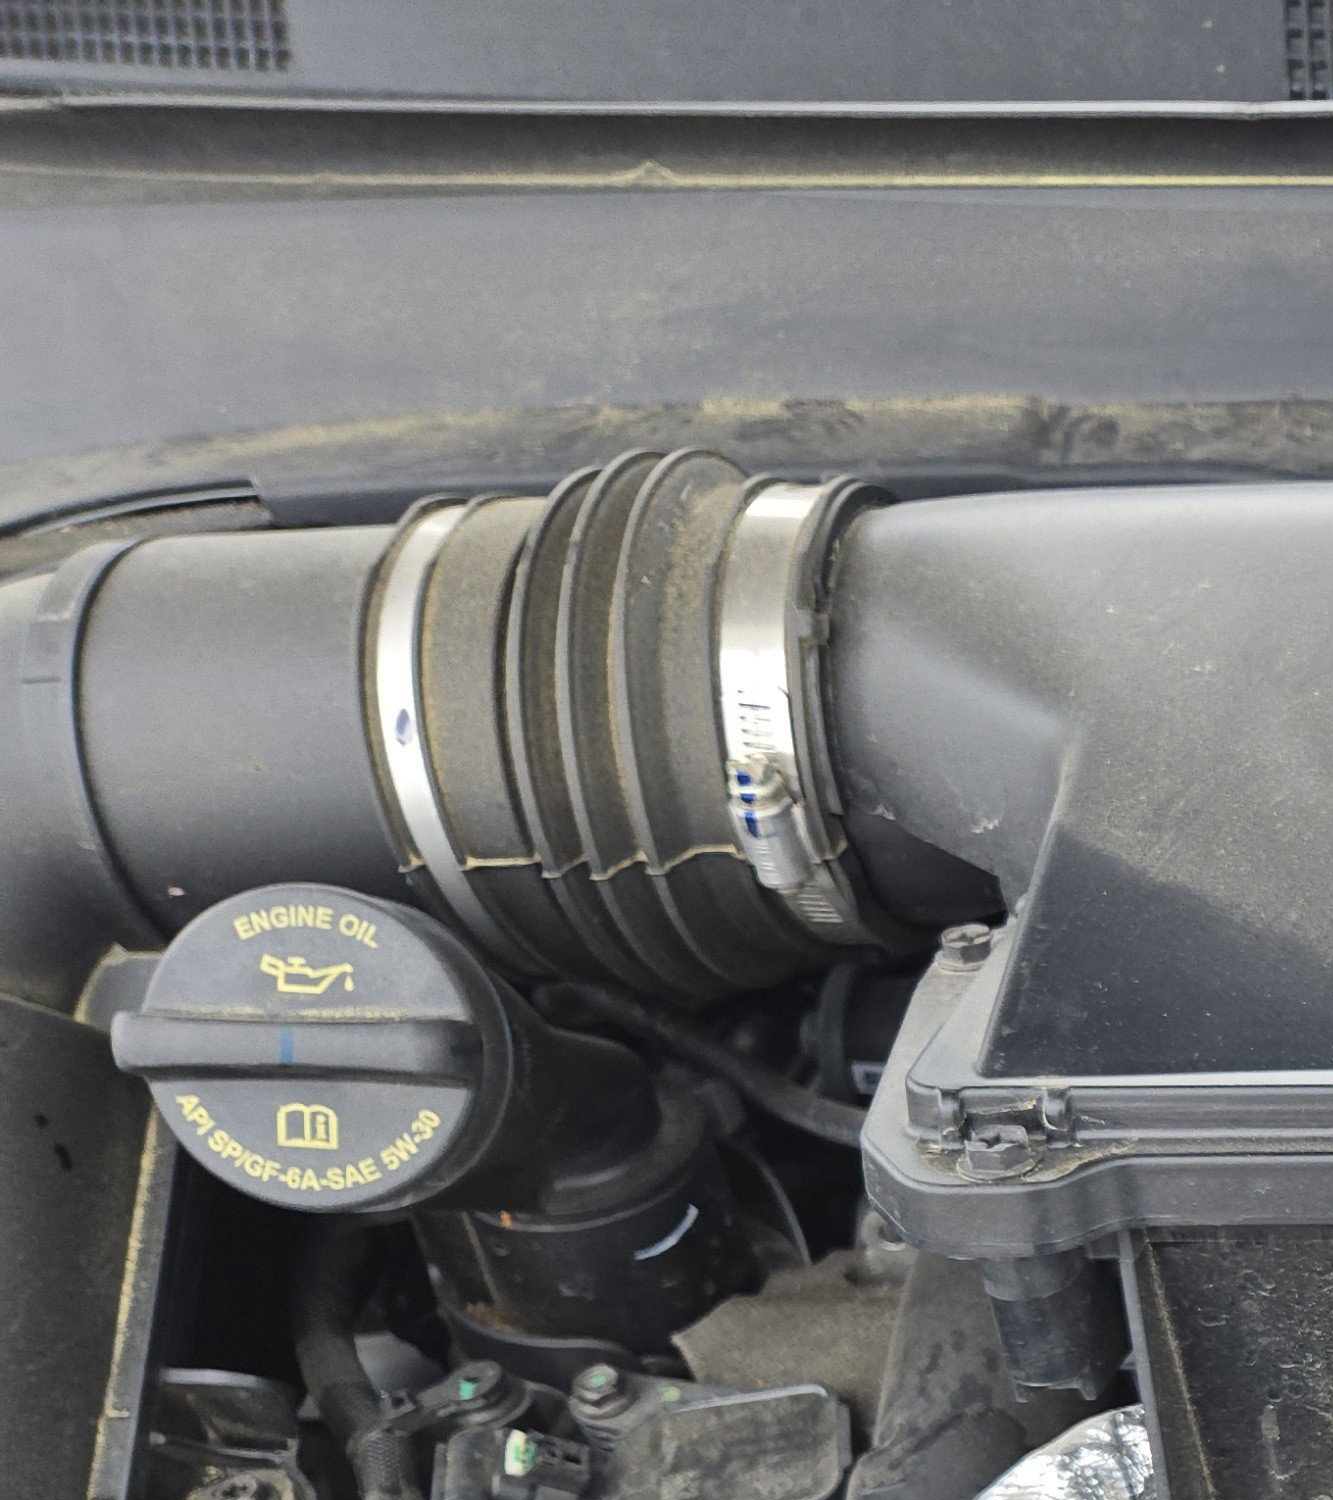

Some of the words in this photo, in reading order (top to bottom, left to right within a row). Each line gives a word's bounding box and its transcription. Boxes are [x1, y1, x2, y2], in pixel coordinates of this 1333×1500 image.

[232, 904, 334, 942] ENGINE
[337, 913, 381, 950] OIL
[175, 1090, 209, 1137] API
[380, 1110, 442, 1174] 5W-30
